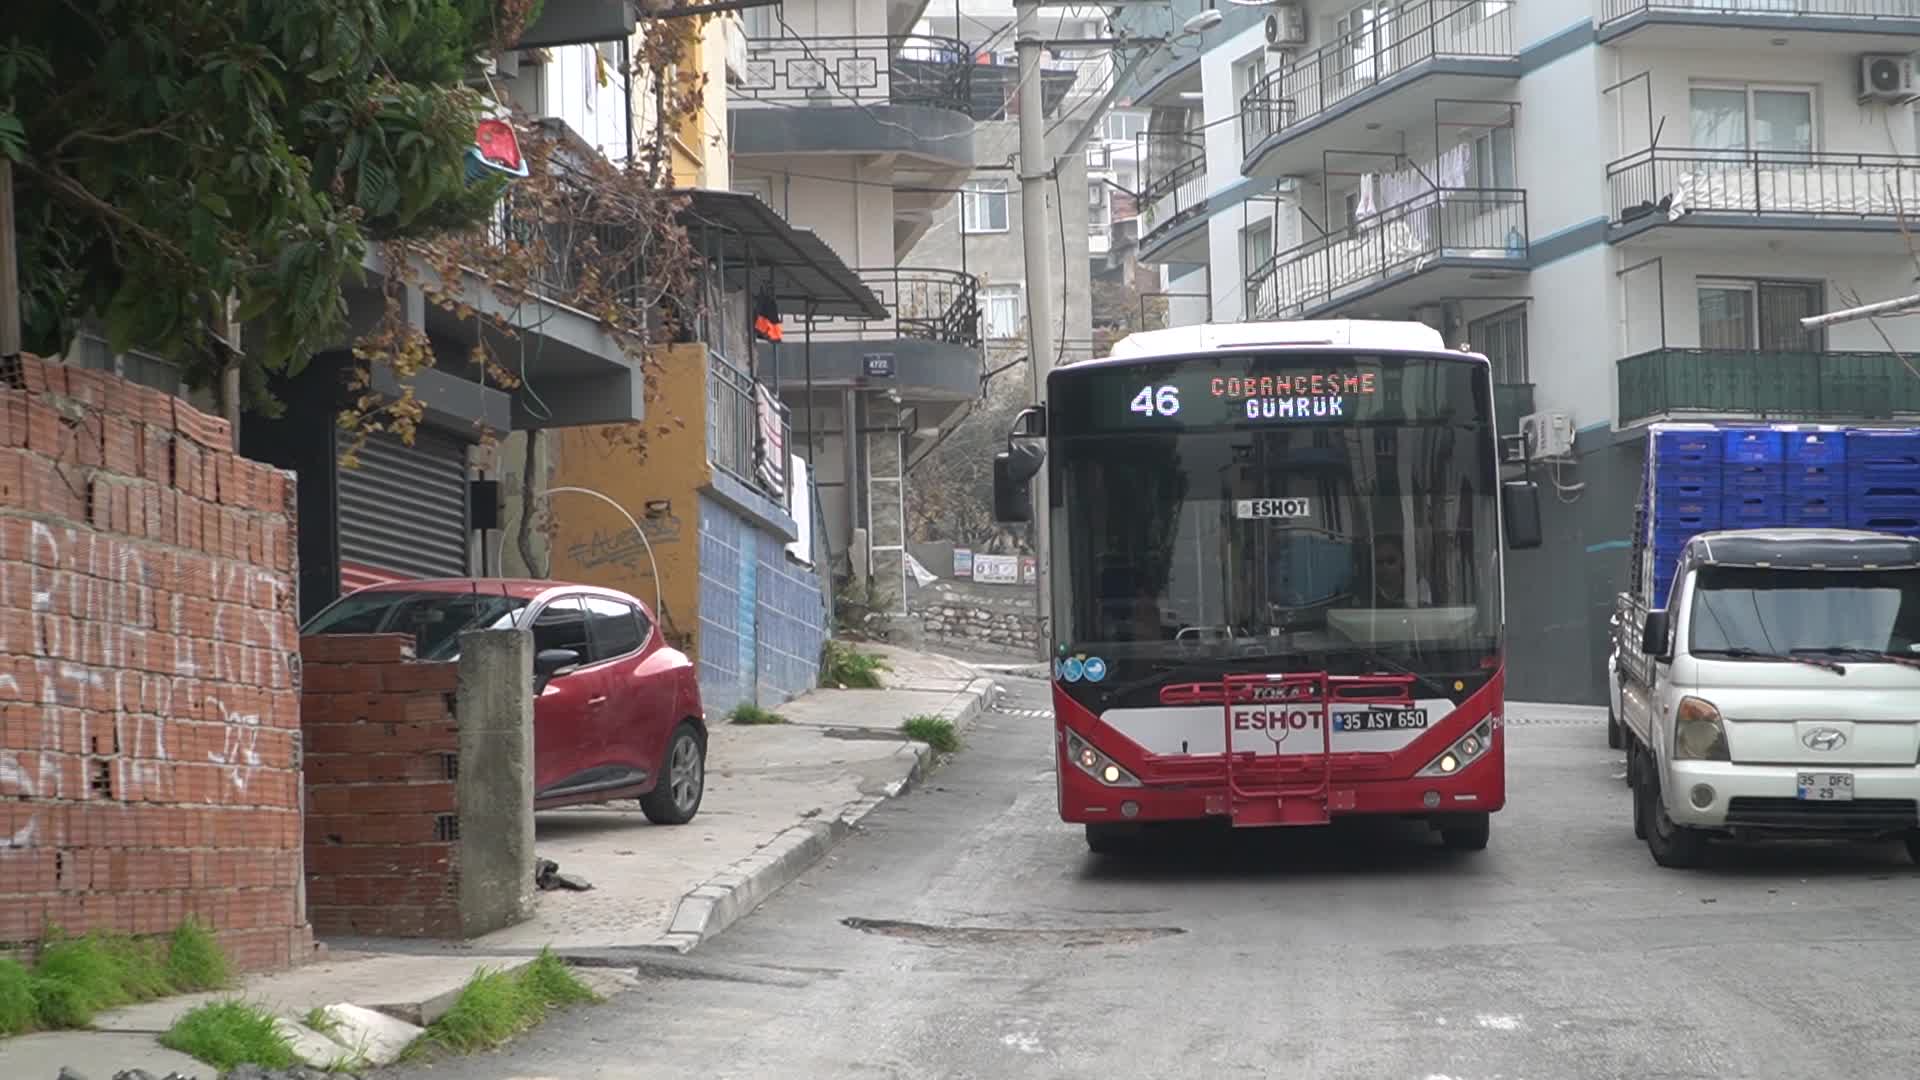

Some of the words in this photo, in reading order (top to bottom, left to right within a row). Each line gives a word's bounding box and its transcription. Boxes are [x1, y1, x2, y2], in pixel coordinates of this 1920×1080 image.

[1130, 385, 1180, 417] 46
[1246, 396, 1343, 418] GÜMRÜK
[1252, 500, 1306, 516] ESHOT
[1234, 711, 1322, 730] ESHOT
[1343, 713, 1361, 730] 35
[1367, 712, 1393, 728] ASY
[1398, 710, 1425, 727] 650
[1799, 775, 1815, 786] 35
